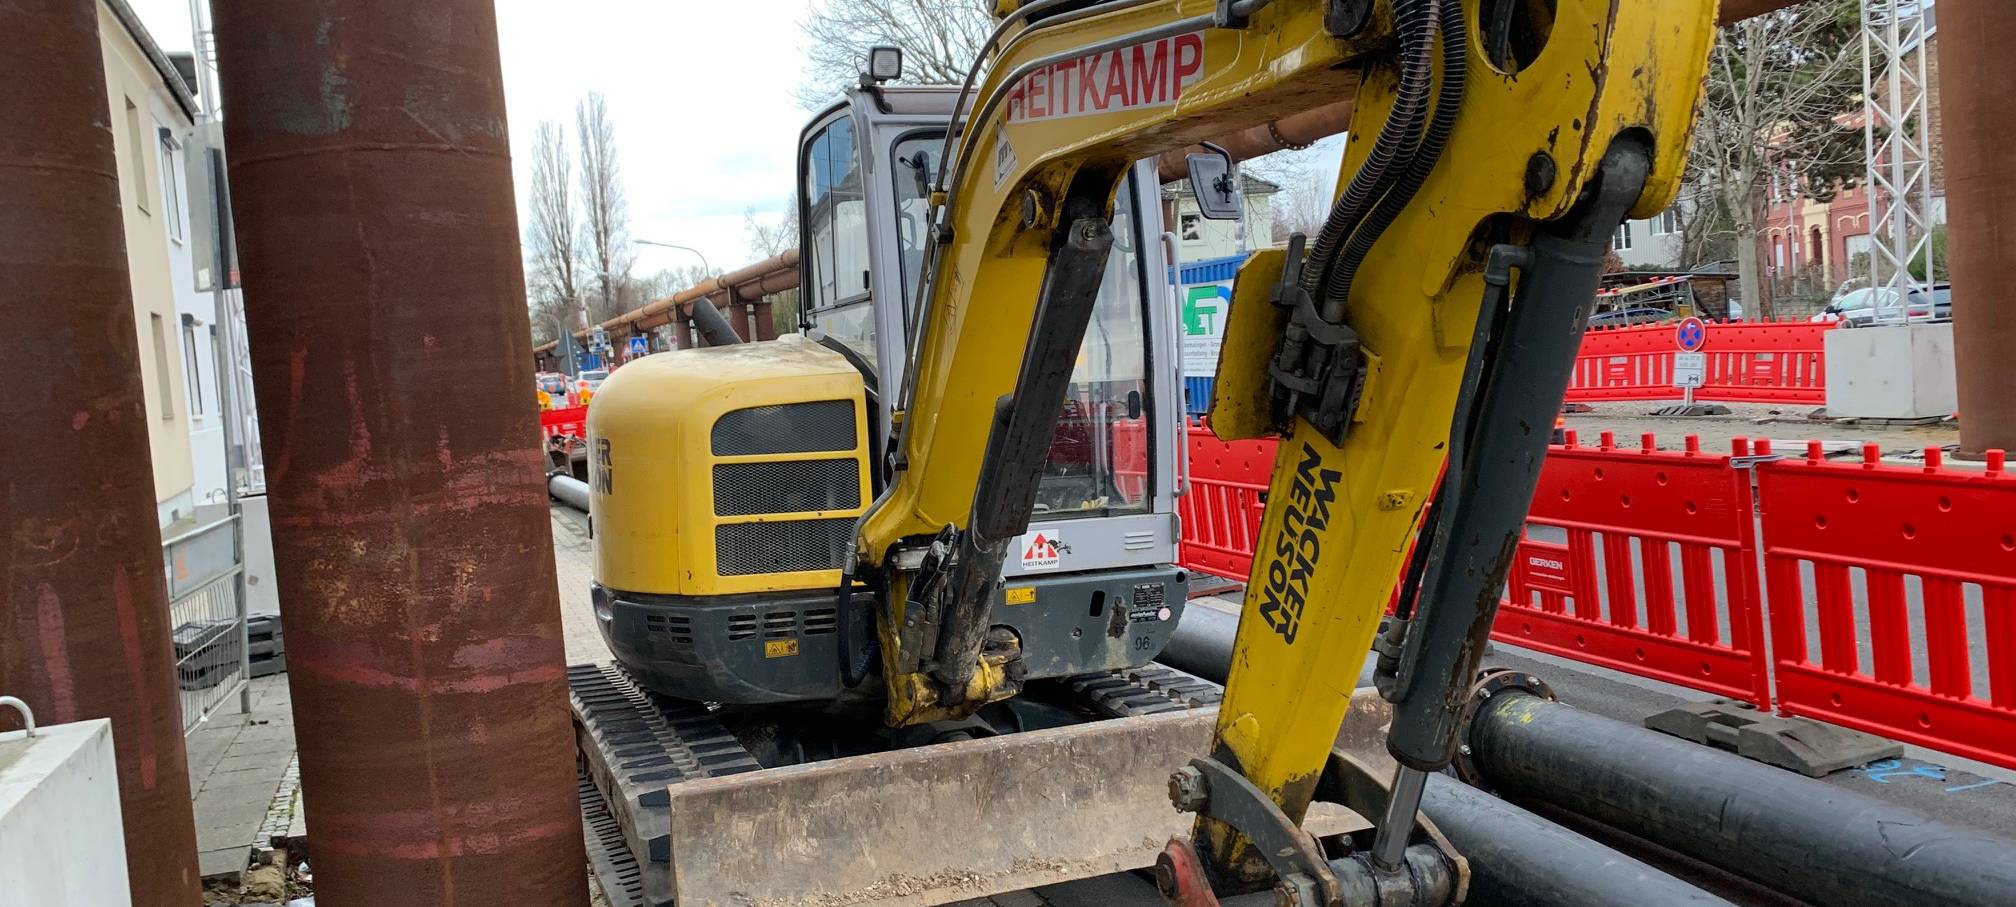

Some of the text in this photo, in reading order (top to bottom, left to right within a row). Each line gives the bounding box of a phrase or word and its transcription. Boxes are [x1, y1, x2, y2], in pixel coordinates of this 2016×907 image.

[1007, 34, 1203, 121] HEITKAMP
[1022, 559, 1058, 567] HEITKAMP
[1260, 441, 1322, 630] NEUSON
[1275, 468, 1343, 645] WACKER
